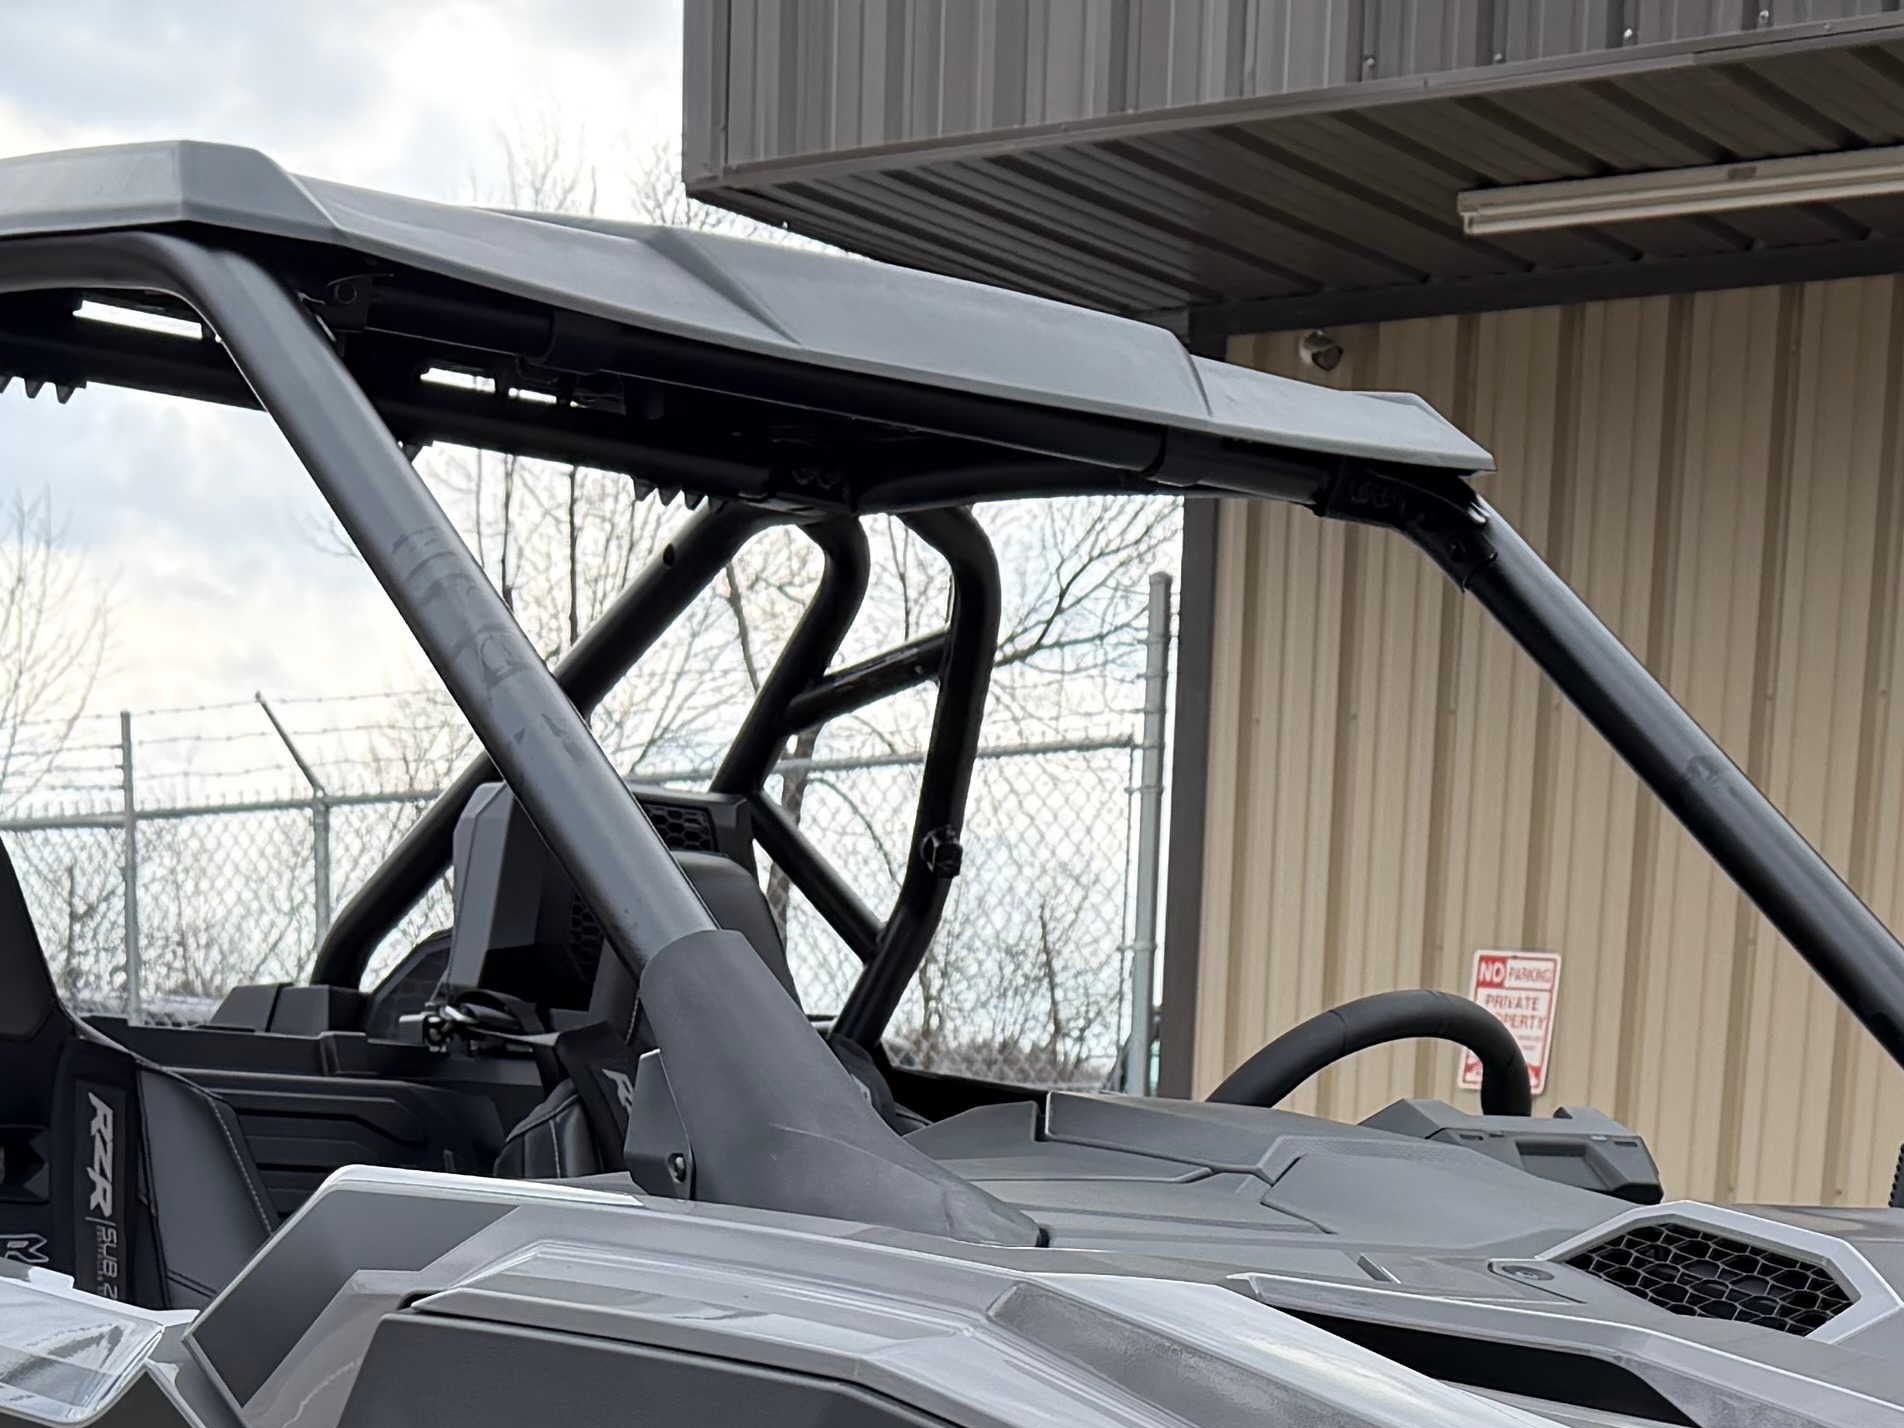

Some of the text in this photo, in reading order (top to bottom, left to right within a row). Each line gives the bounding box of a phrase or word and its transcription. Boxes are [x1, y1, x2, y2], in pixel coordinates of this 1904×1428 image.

[1478, 960, 1552, 983] NO PARKING
[1485, 993, 1540, 1012] PRIVATE
[87, 1092, 114, 1218] RZR
[102, 1226, 117, 1278] SUB
